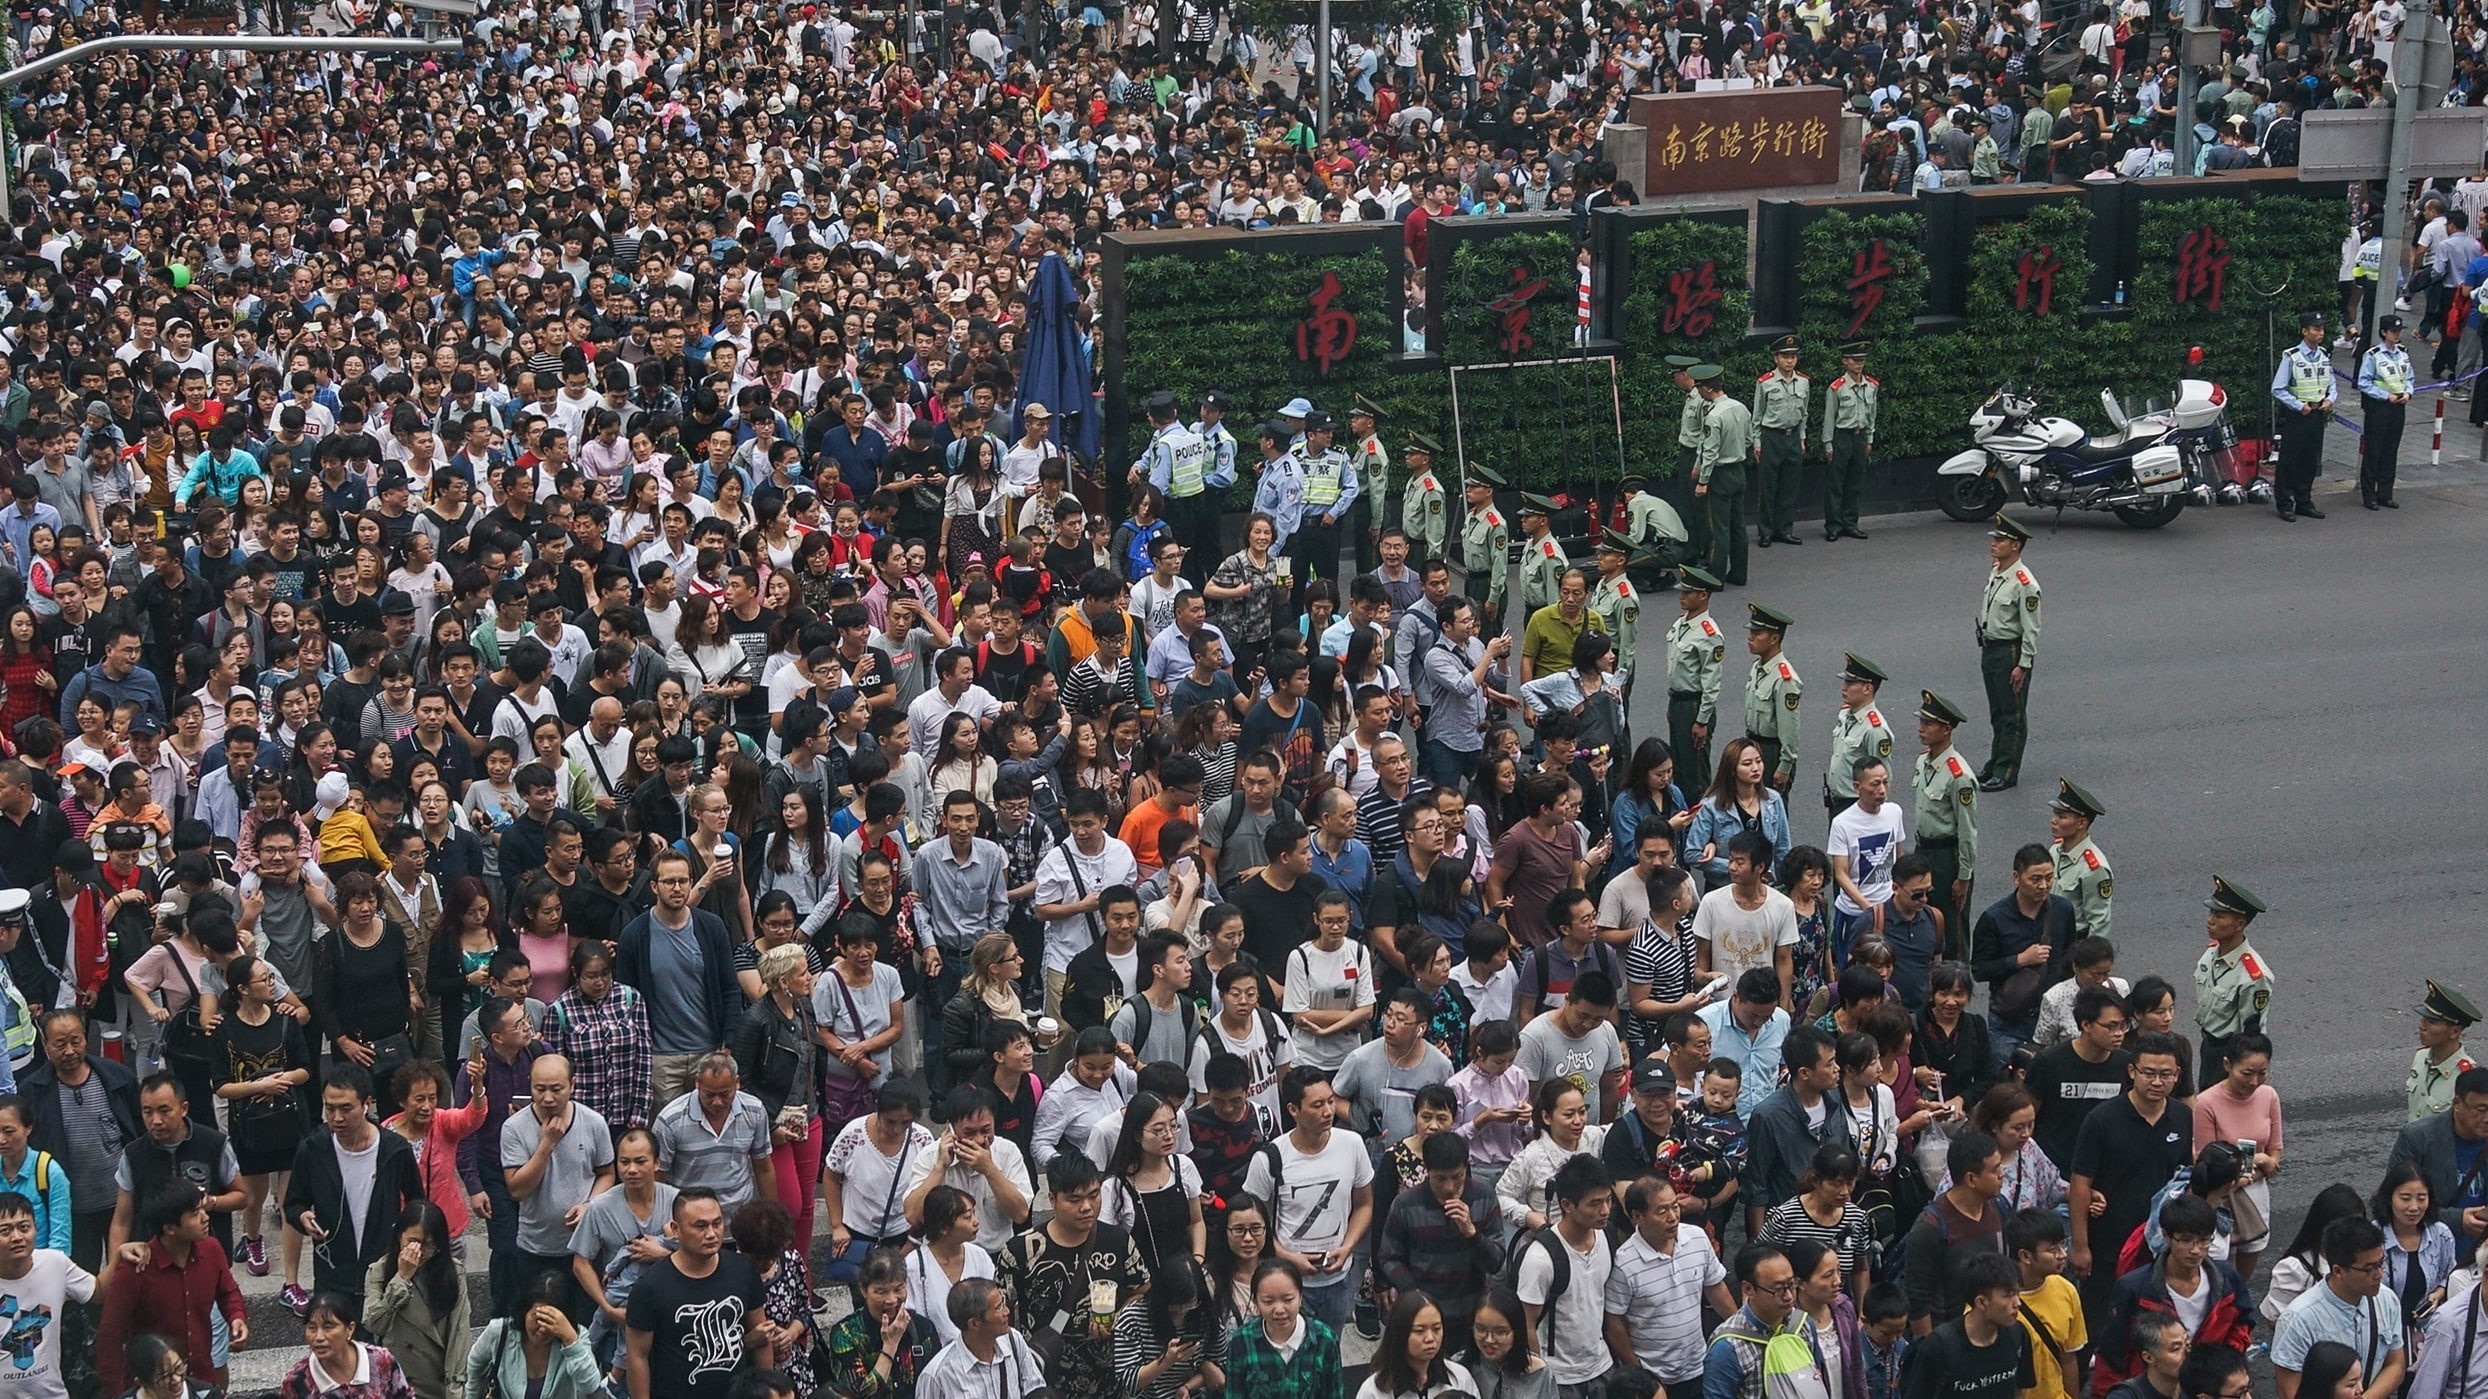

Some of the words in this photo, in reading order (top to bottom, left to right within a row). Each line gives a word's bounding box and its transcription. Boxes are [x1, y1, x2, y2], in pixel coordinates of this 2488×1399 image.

[1662, 116, 1829, 171] 南京路步行街
[2359, 251, 2380, 263] OLICE
[1175, 442, 1203, 461] POLICE
[858, 674, 881, 687] das
[1248, 1074, 1278, 1098] FORNIA
[2065, 1084, 2079, 1096] 21
